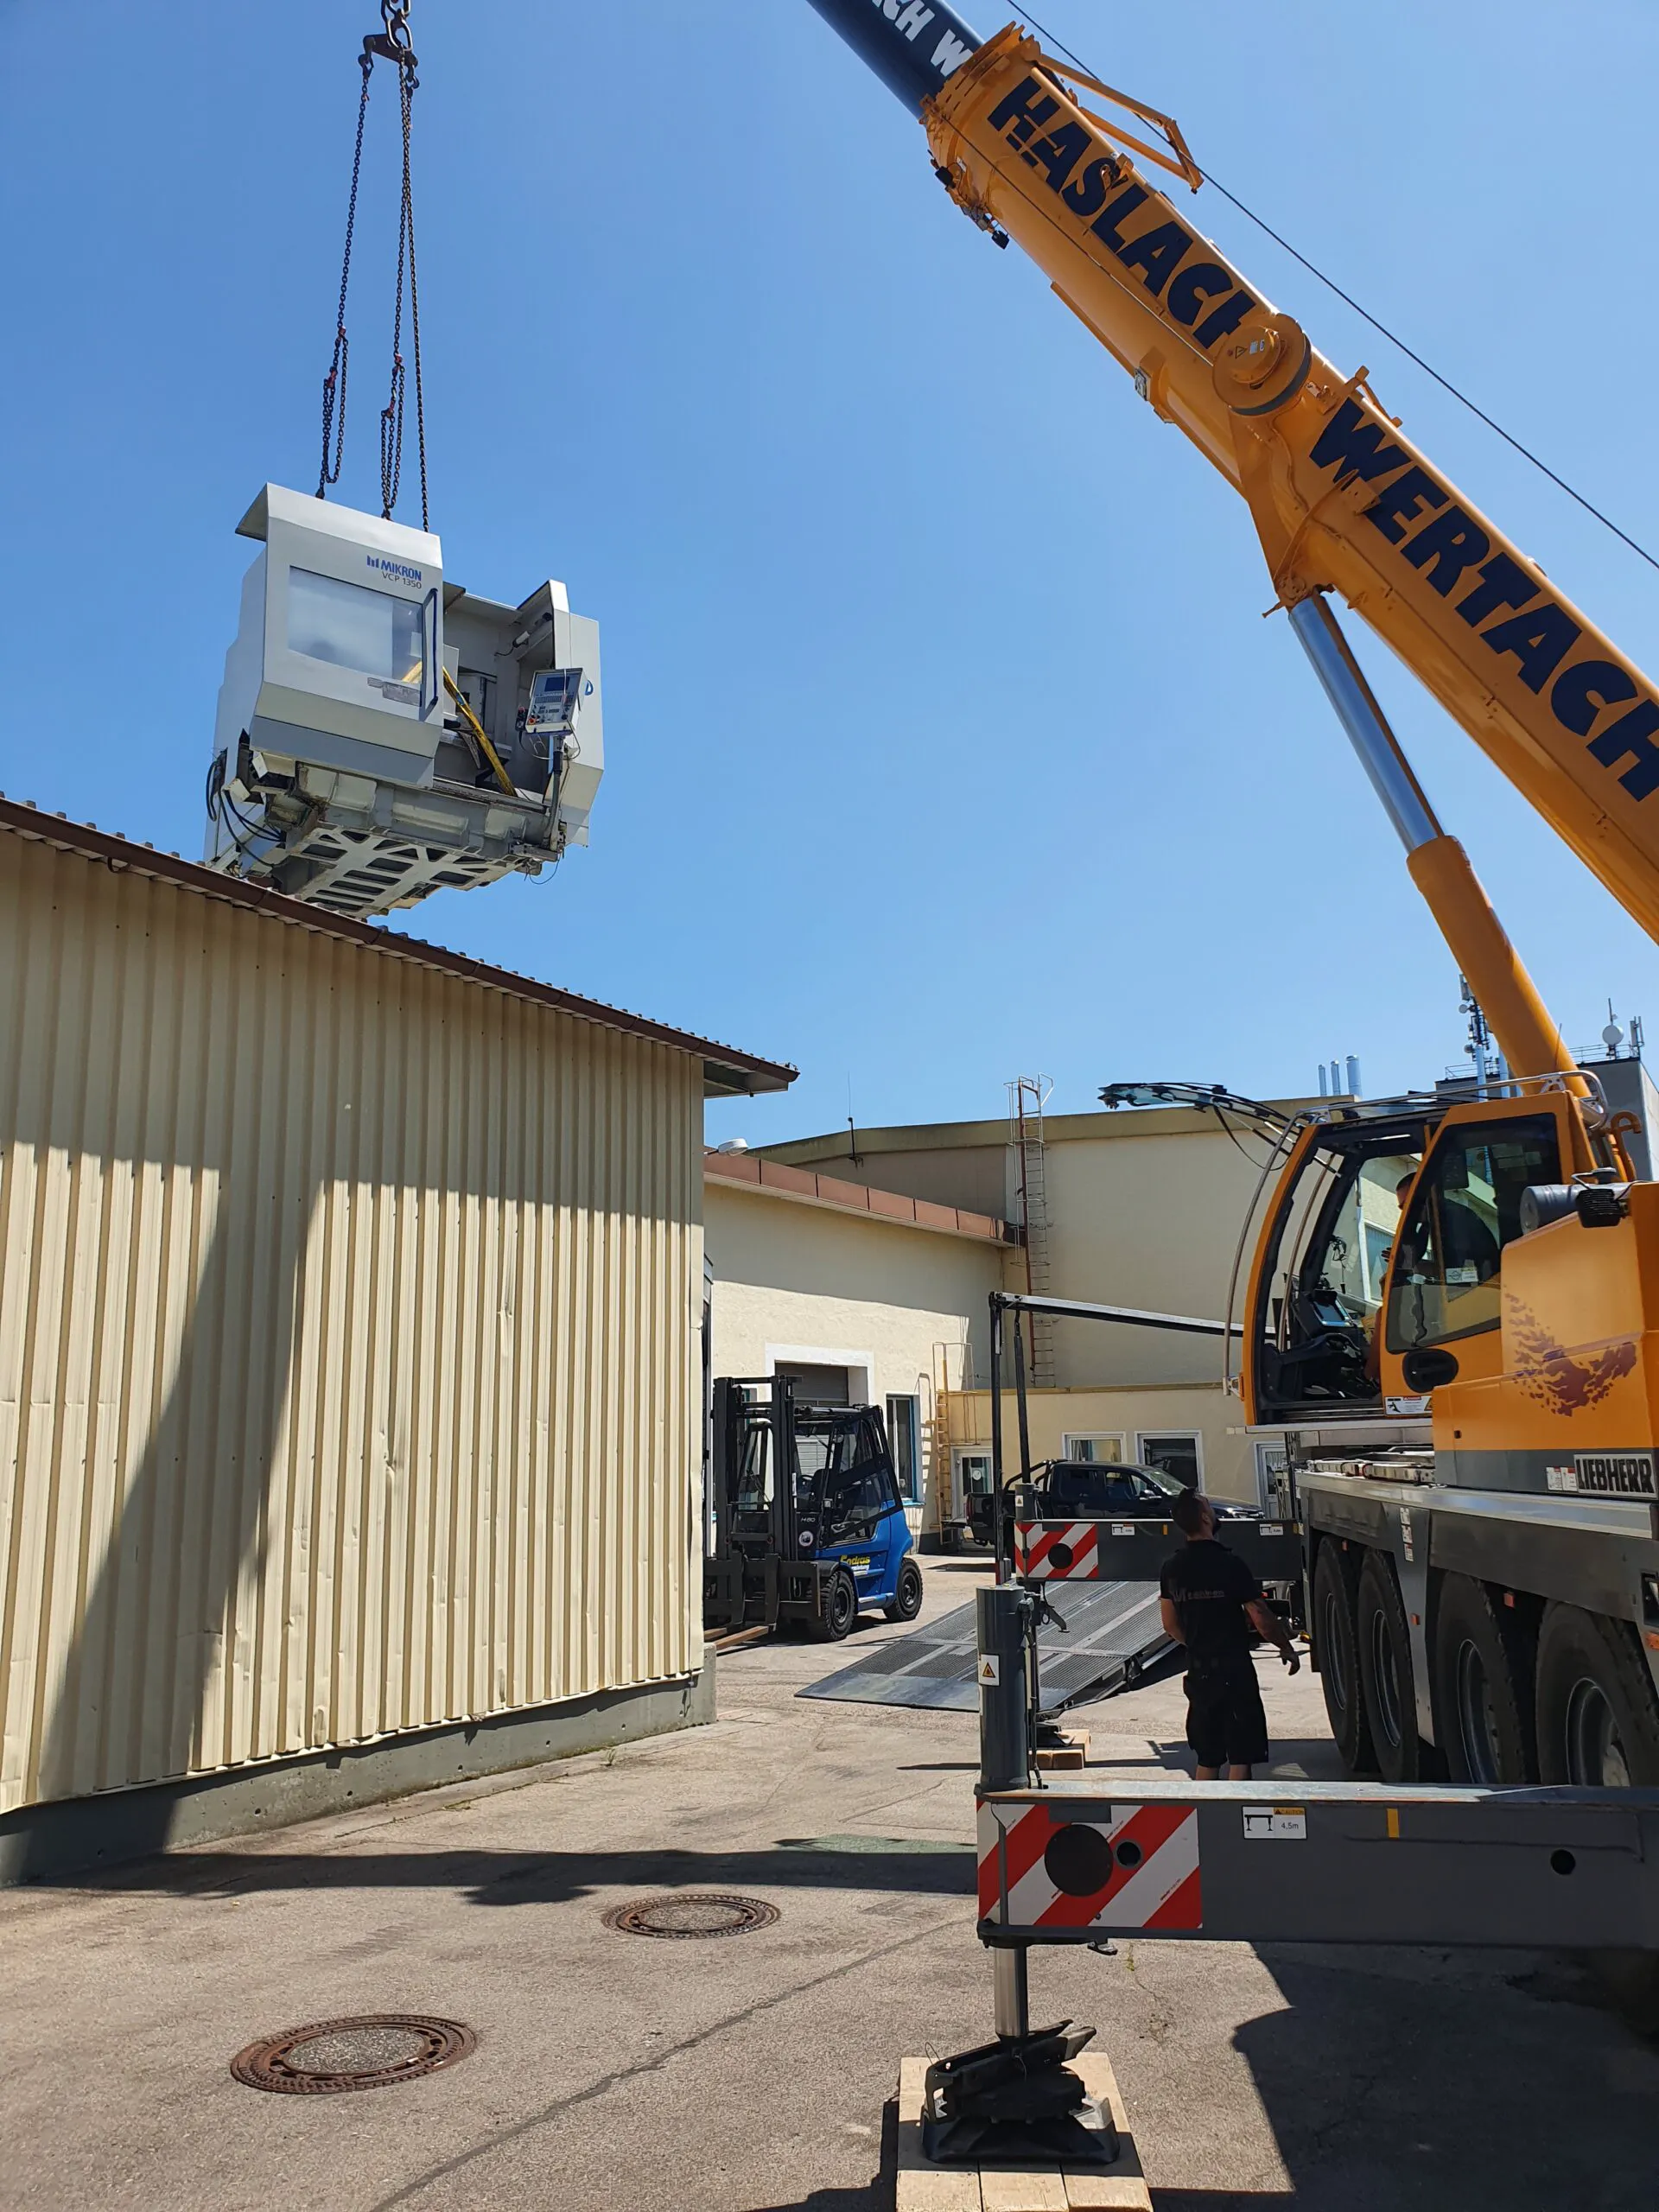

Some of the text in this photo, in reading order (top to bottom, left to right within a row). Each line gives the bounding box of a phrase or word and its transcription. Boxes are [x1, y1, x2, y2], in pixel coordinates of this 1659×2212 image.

[871, 0, 936, 42] CH
[380, 559, 423, 582] MIKRON
[381, 571, 423, 589] VCP 1350
[1308, 397, 1659, 803] WERTACH
[1575, 1458, 1655, 1493] LIEBHERR
